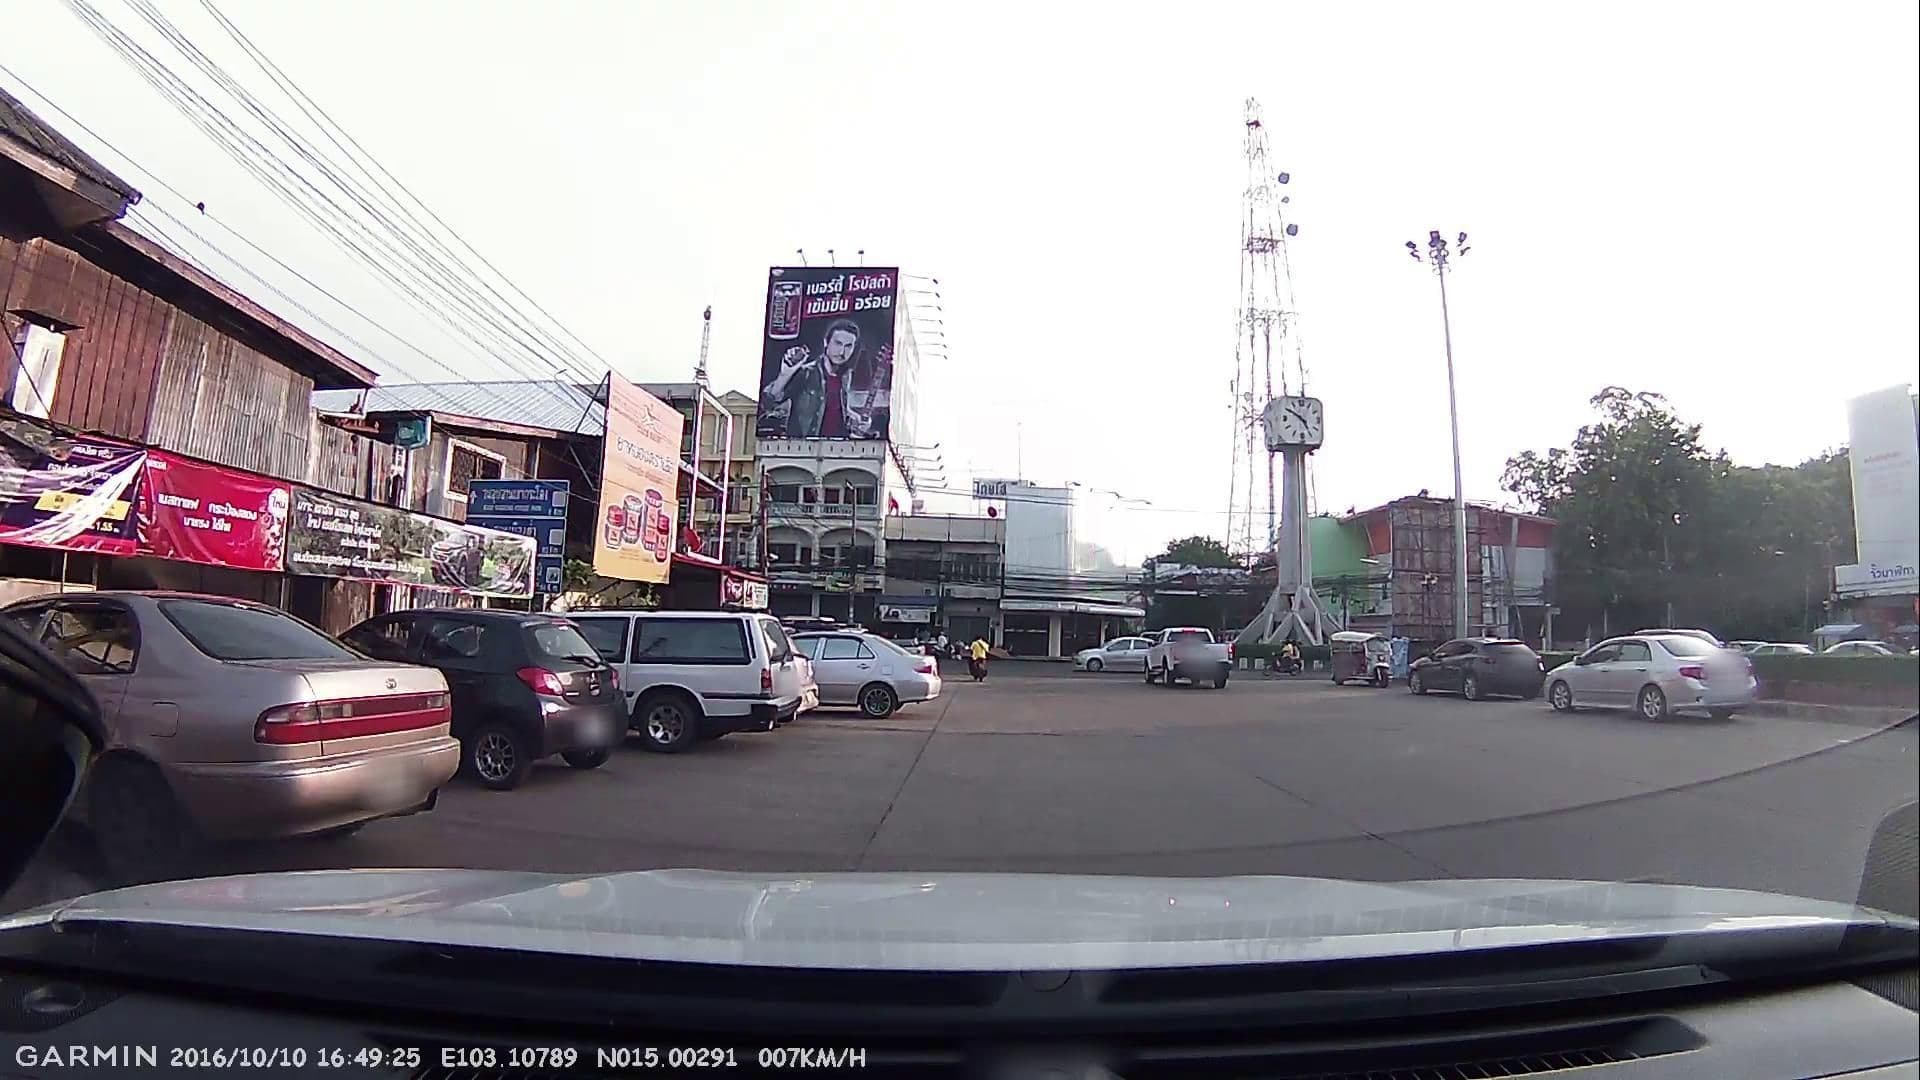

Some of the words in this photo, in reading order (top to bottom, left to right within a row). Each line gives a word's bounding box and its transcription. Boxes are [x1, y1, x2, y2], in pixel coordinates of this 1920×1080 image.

[806, 275, 845, 296] เบอร์ดี้
[849, 274, 892, 292] โรบัสต้า
[854, 293, 892, 311] อร่อย
